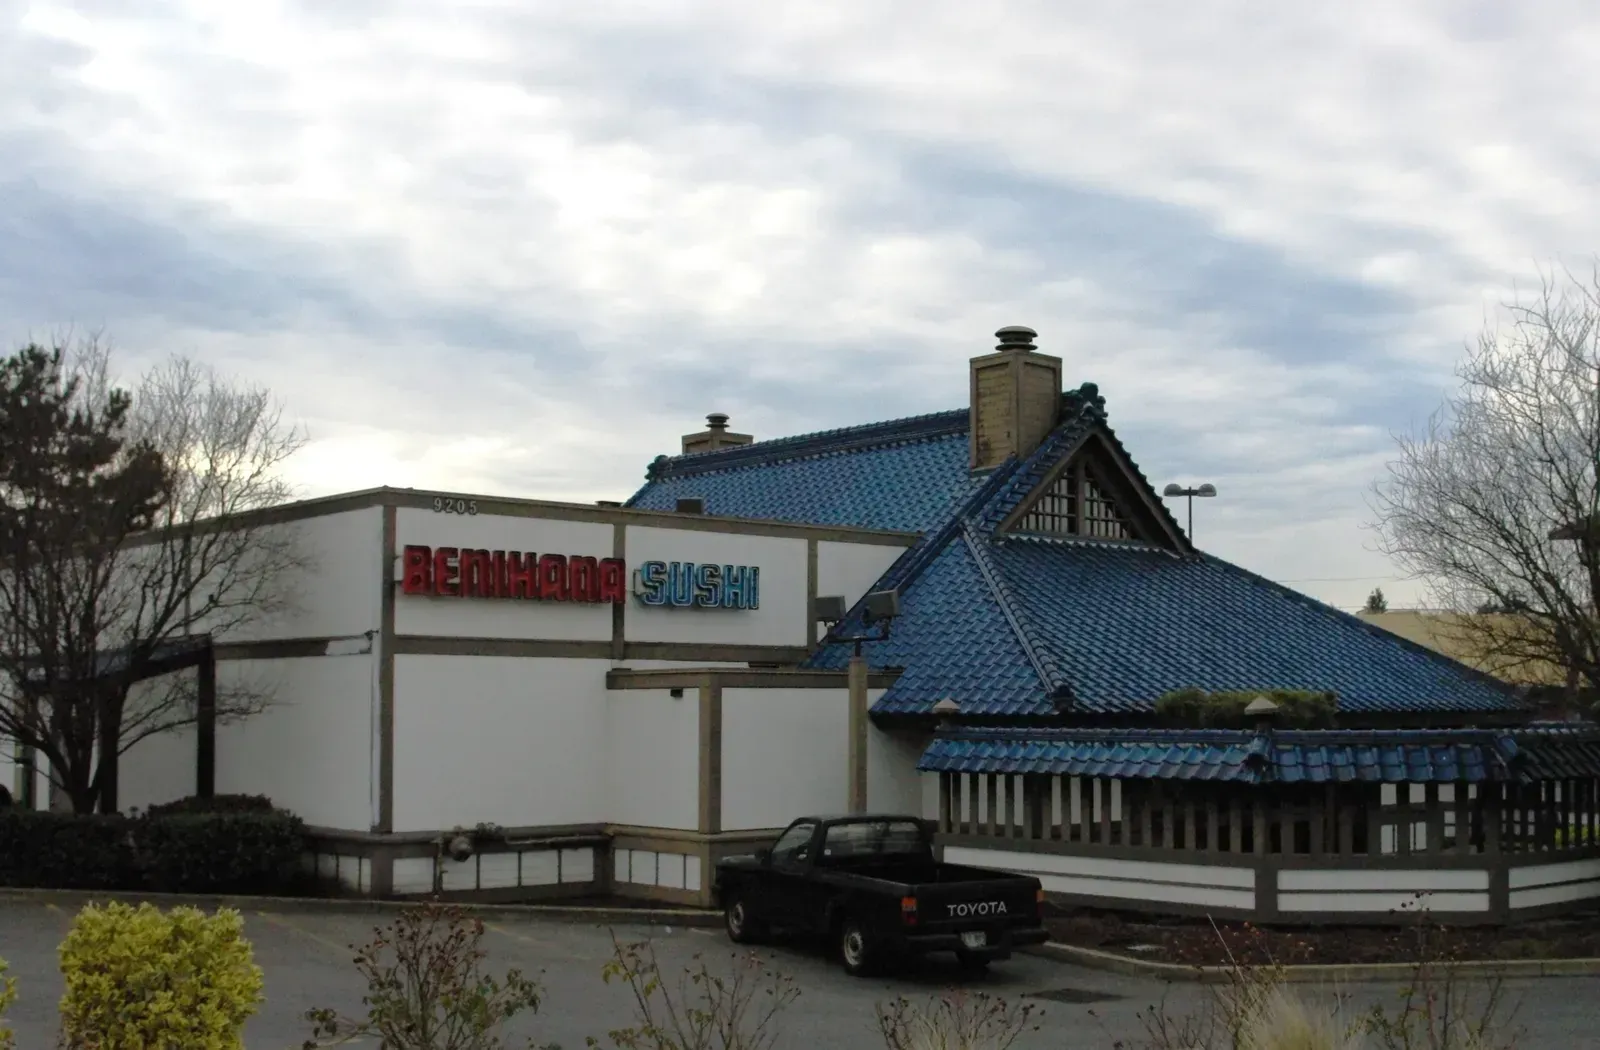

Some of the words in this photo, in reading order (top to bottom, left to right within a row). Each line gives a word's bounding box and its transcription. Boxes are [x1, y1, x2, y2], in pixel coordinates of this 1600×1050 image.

[433, 496, 479, 515] 9205
[403, 544, 626, 604] BENIHANA
[640, 560, 760, 610] SUSHI
[946, 900, 1007, 917] TOYOTA
